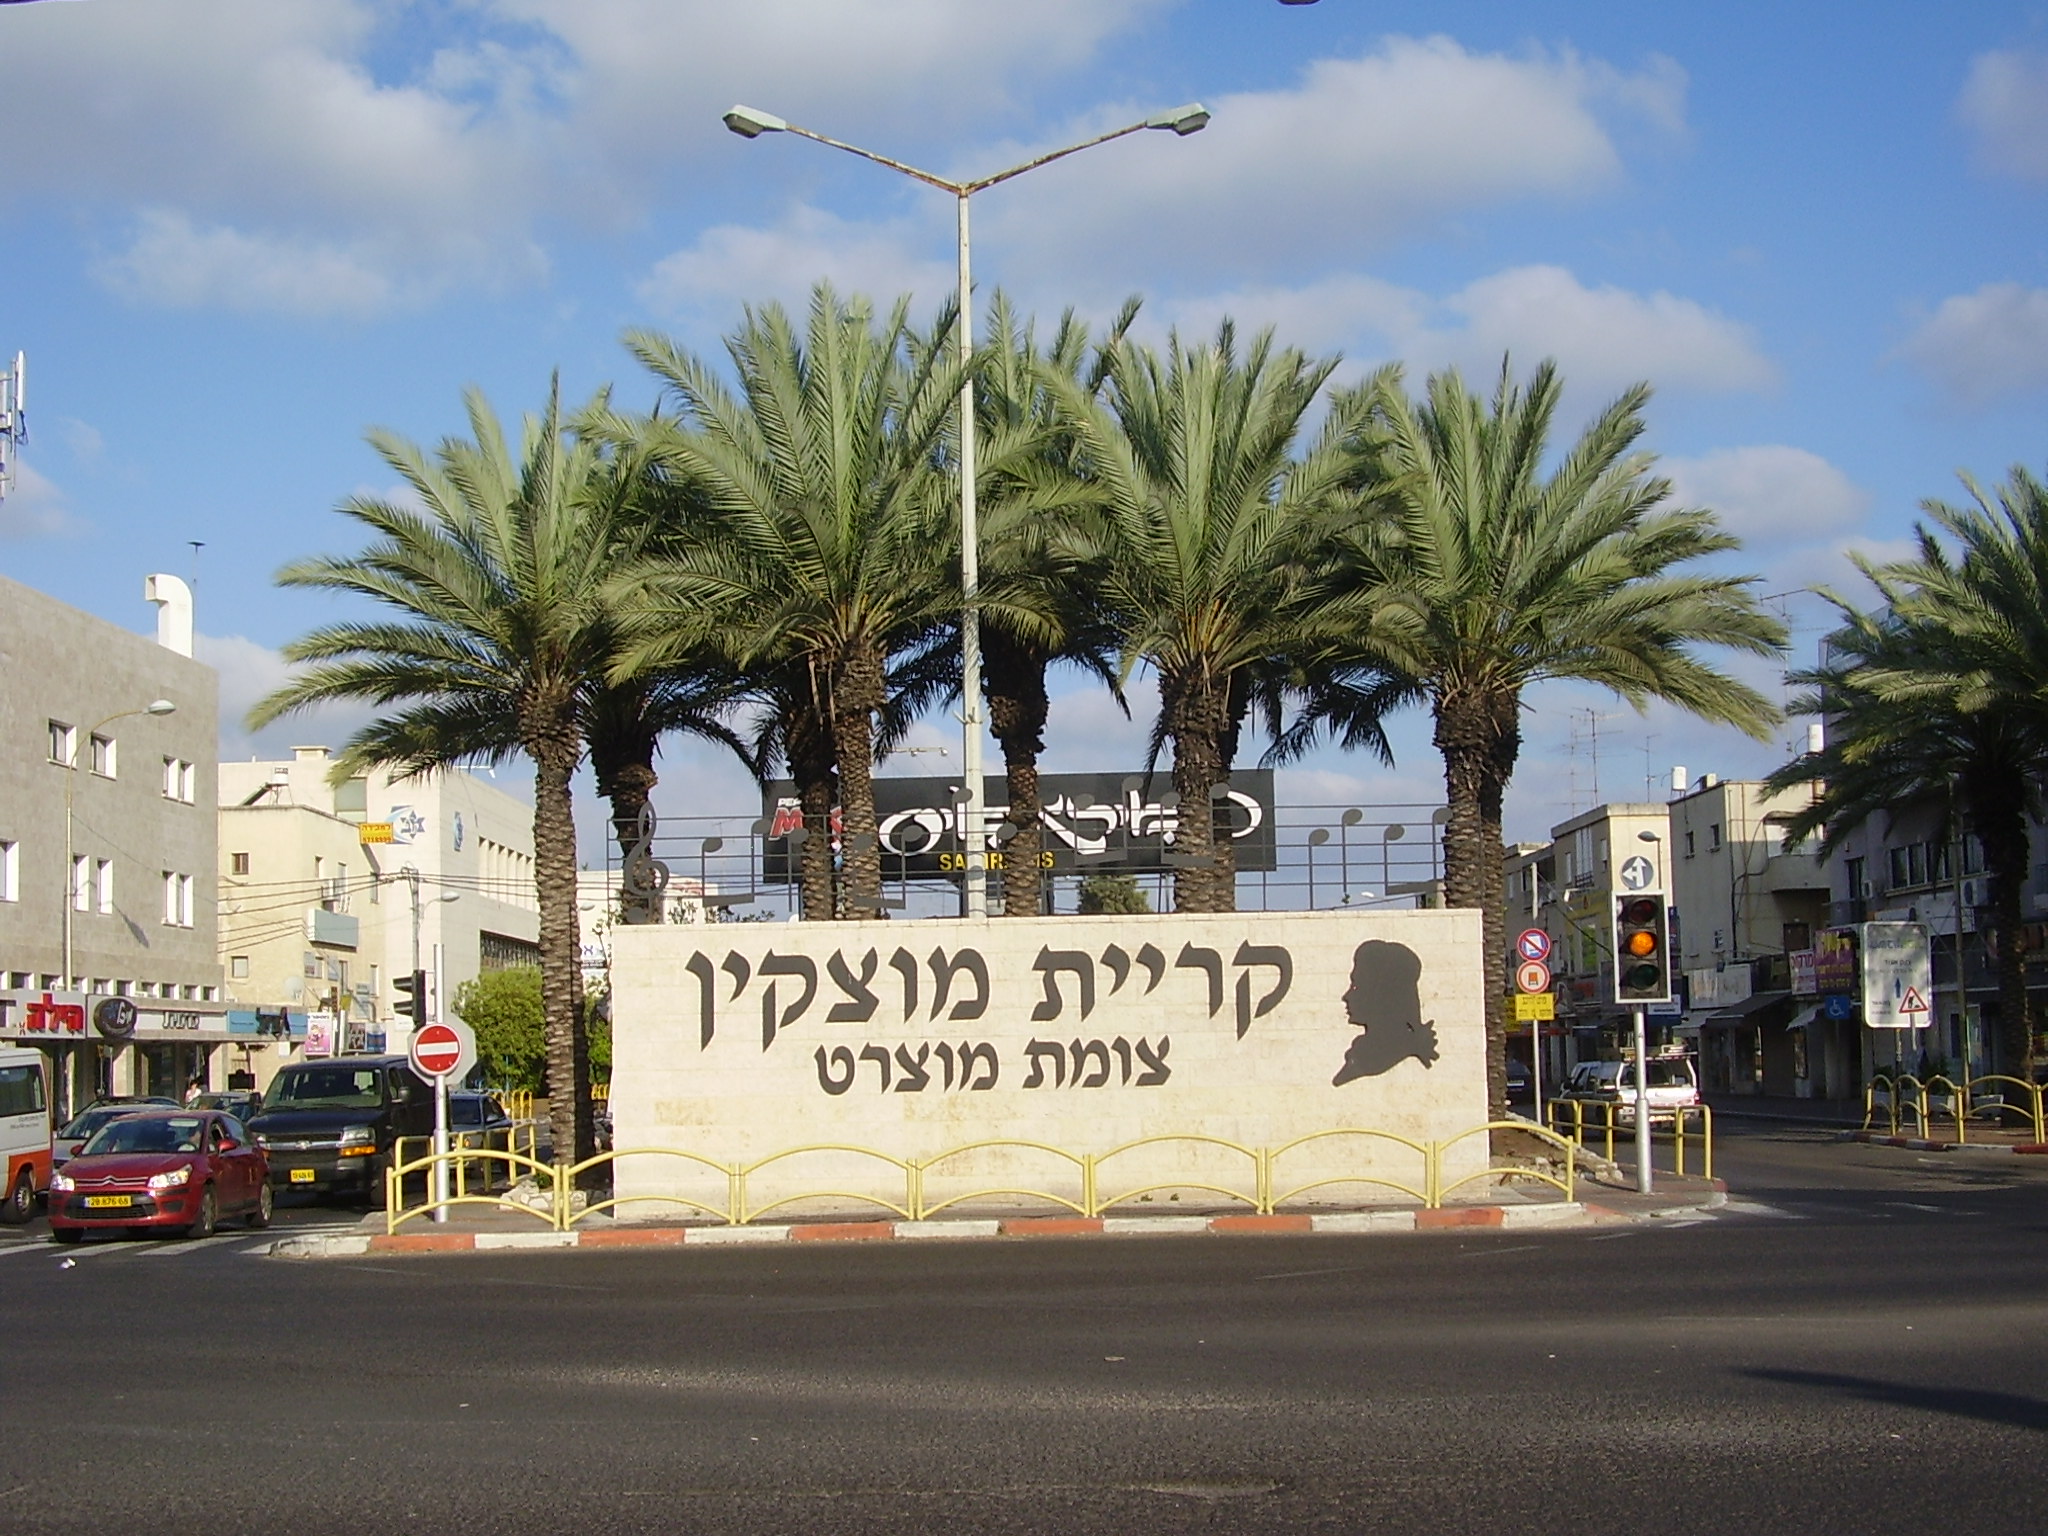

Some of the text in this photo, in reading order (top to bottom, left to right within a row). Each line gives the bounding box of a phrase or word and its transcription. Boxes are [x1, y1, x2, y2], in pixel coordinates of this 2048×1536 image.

[686, 940, 1292, 1052] קריית מוצקין
[815, 1036, 1172, 1096] צומת מוצרט
